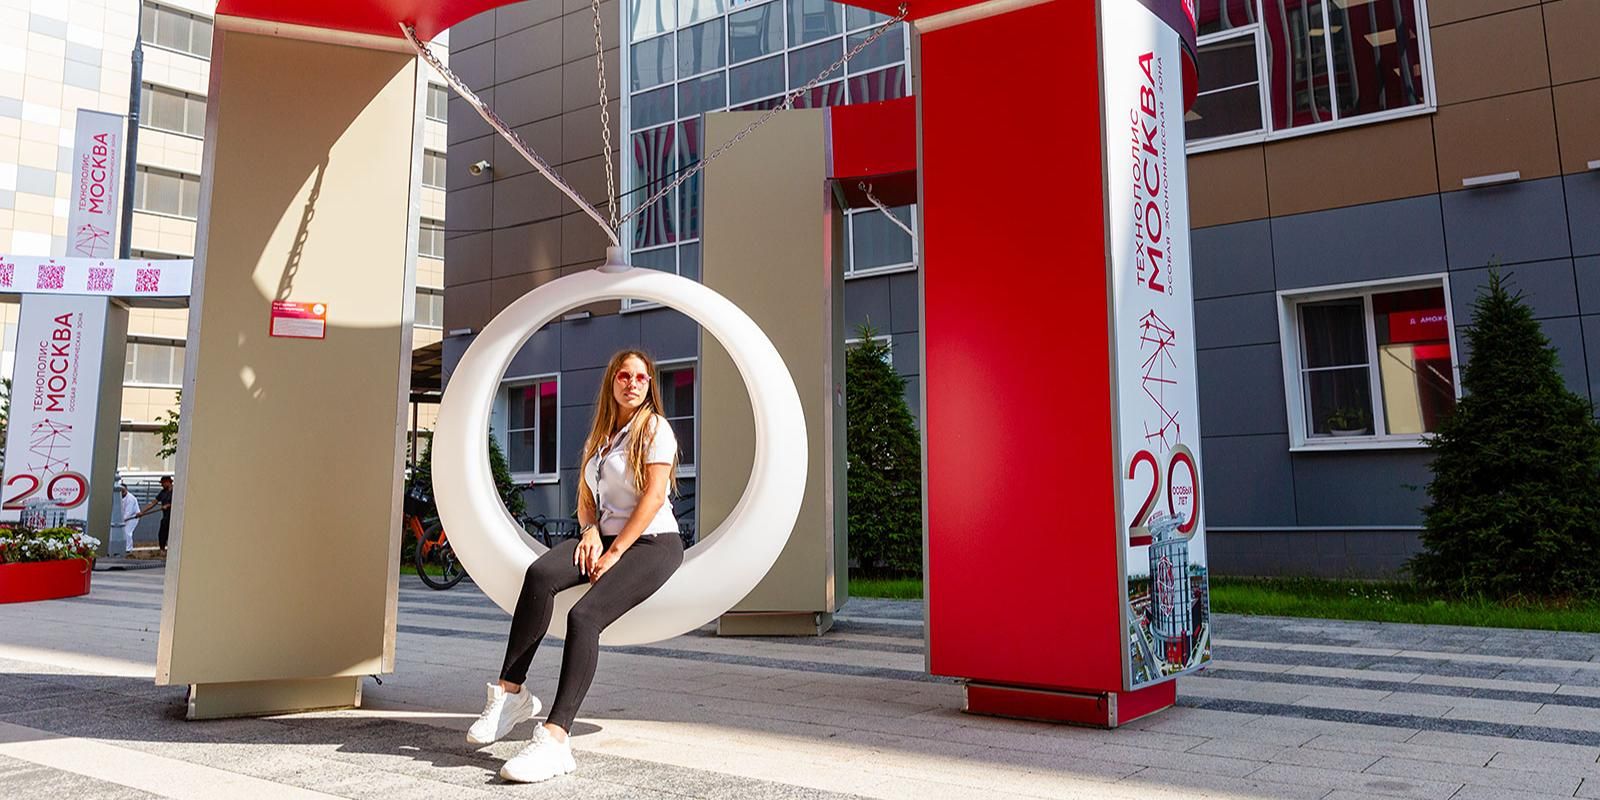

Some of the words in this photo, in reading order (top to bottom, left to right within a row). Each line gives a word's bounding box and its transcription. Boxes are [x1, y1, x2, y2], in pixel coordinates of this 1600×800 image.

[1156, 56, 1164, 94] ЗОНА
[79, 153, 90, 211] ТЕХНОПОЛИС
[88, 133, 108, 214] МОСКВА
[1130, 108, 1146, 285] ТЕХНОПОЛИС
[1138, 50, 1165, 293] МОСКВА
[1159, 100, 1170, 230] ЭКОНОМИЧЕСКАЯ
[1165, 236, 1174, 297] ОСОБАЯ
[33, 340, 49, 412] ТЕХНОПОЛИС
[45, 312, 74, 412] МОСКВА
[73, 331, 81, 384] ЭКОНОМИЧЕСКАЯ
[2, 471, 89, 510] 20
[1124, 444, 1200, 546] 20
[1172, 486, 1192, 495] ОСОБЫХ
[1178, 496, 1188, 505] ЛЕТ
